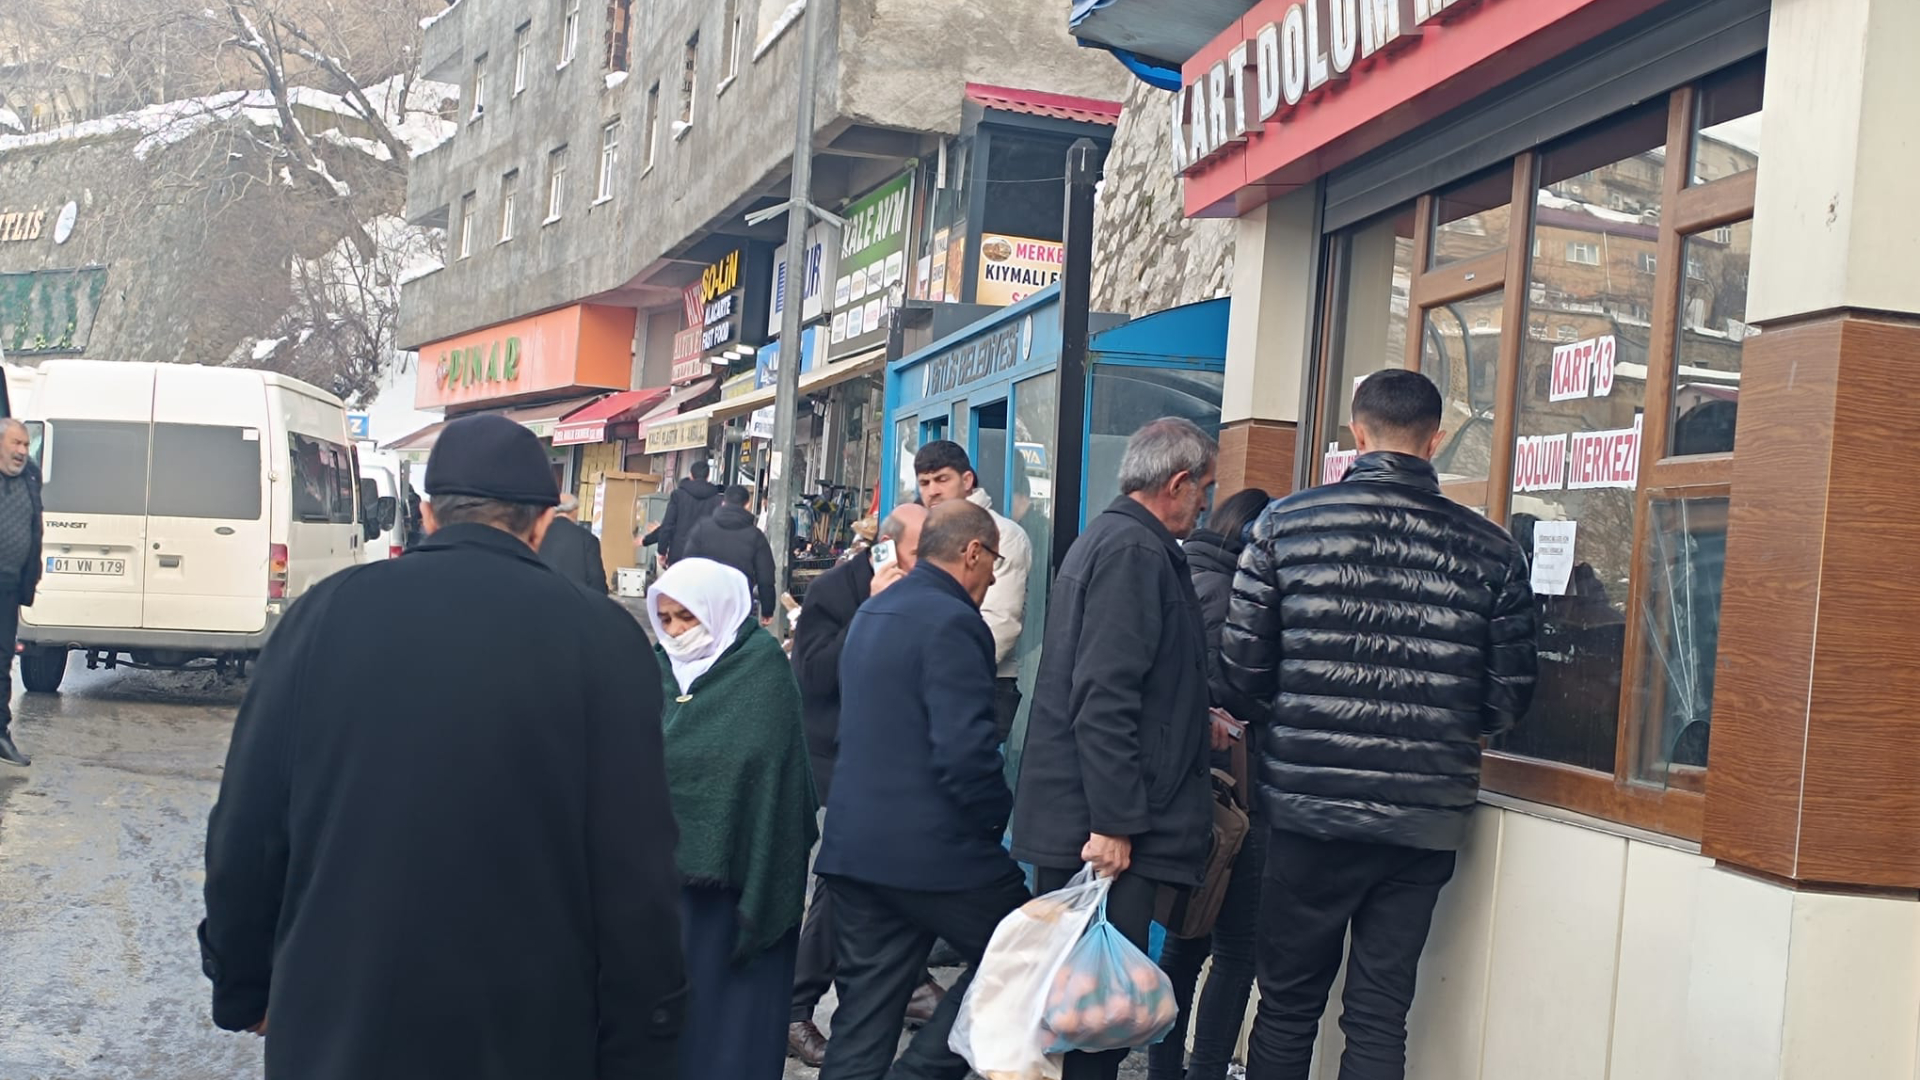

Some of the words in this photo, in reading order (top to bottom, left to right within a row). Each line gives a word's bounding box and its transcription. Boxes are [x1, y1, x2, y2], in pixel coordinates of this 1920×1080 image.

[1170, 39, 1249, 177] KART
[1256, 0, 1400, 123] DOLUM
[841, 205, 874, 260] KALE
[873, 186, 906, 244] AVM
[985, 264, 1046, 287] KIYMALI
[713, 321, 729, 346] FOOD
[957, 322, 1020, 386] BELEDİYESİ
[447, 336, 521, 391] PINAR
[1552, 345, 1593, 396] KART
[1595, 341, 1613, 390] 13
[1515, 440, 1564, 487] DOLUM
[1570, 420, 1640, 483] MERKEZİ
[45, 520, 88, 529] TRANSIT
[55, 559, 69, 571] 01
[77, 560, 92, 572] VN
[100, 561, 123, 573] 179
